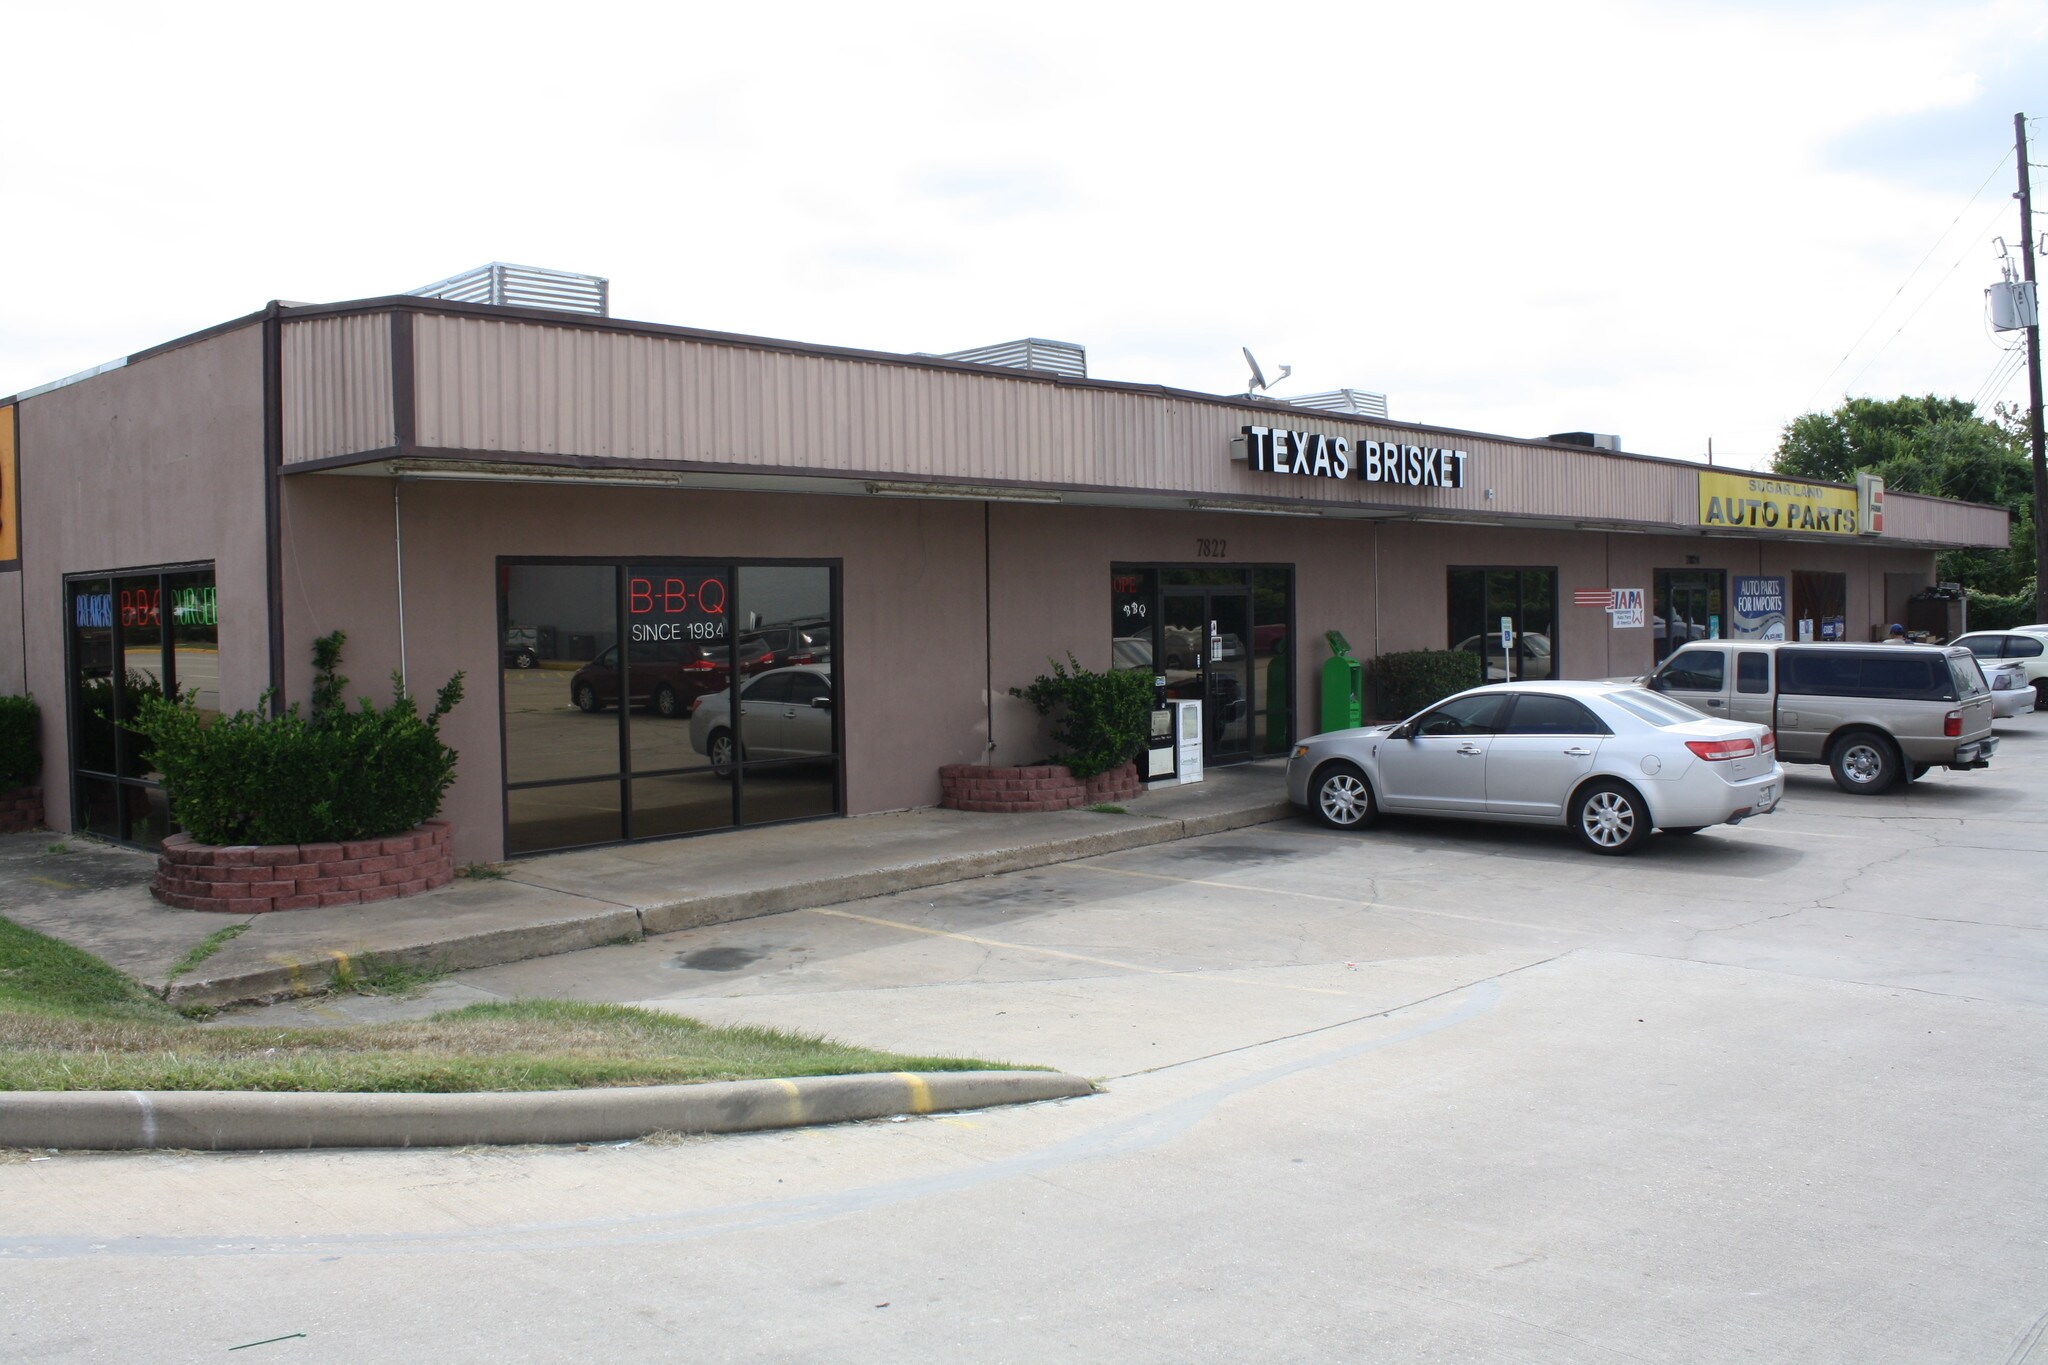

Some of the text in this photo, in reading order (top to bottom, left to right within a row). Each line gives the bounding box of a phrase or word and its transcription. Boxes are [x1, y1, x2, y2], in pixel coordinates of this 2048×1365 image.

[1250, 425, 1468, 489] TEXAS BRISKET
[1748, 479, 1824, 499] SUGAR LAND
[1705, 496, 1857, 533] AUTO PARTS
[1196, 538, 1227, 557] 7822
[629, 578, 727, 614] B-B-Q
[1740, 580, 1780, 595] AUTO PARTS
[1615, 591, 1643, 609] IAPA
[1738, 596, 1782, 612] FOR IMPORTS
[631, 621, 725, 642] SINCE 1984
